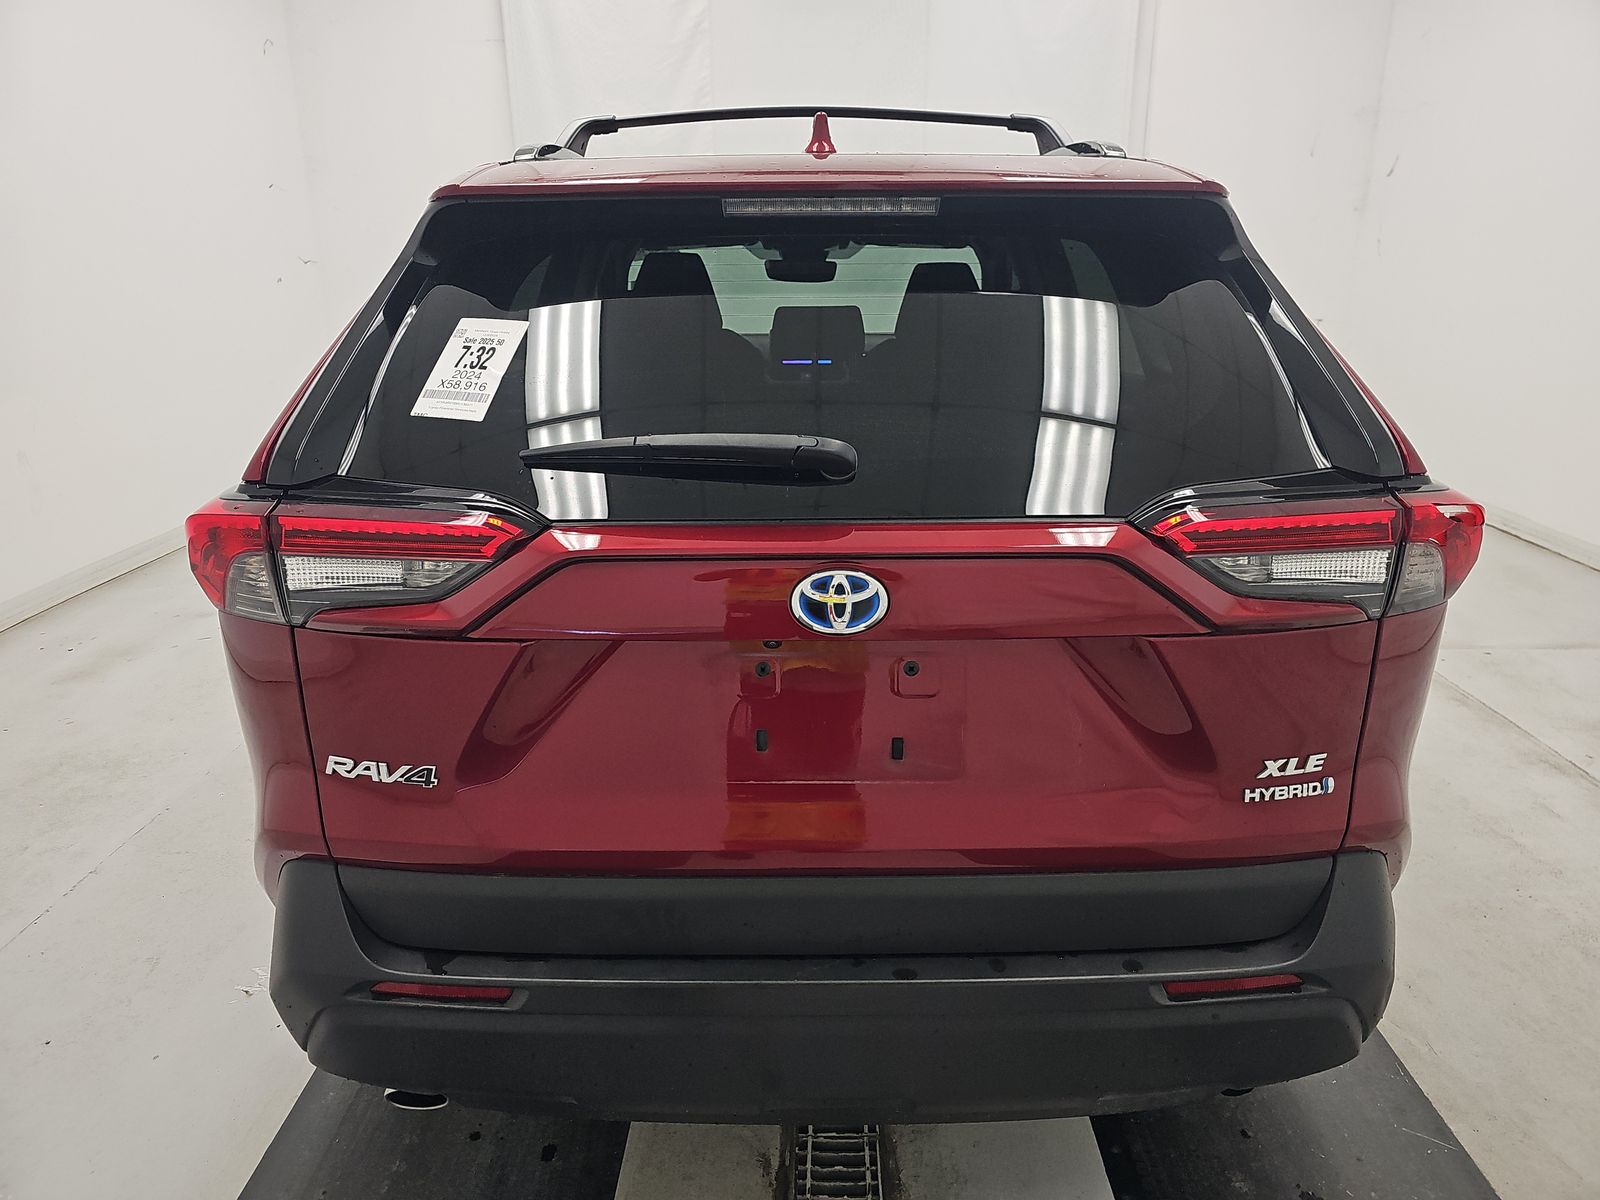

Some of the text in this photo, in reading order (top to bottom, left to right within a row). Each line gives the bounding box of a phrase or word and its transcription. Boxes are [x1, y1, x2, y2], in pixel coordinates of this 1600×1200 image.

[463, 336, 477, 344] Sale
[478, 337, 495, 346] 2025
[454, 345, 497, 370] 7:32
[452, 370, 482, 380] 2024
[325, 755, 438, 788] RAV4
[1256, 753, 1328, 779] XLE
[1244, 781, 1323, 803] HYBRID
